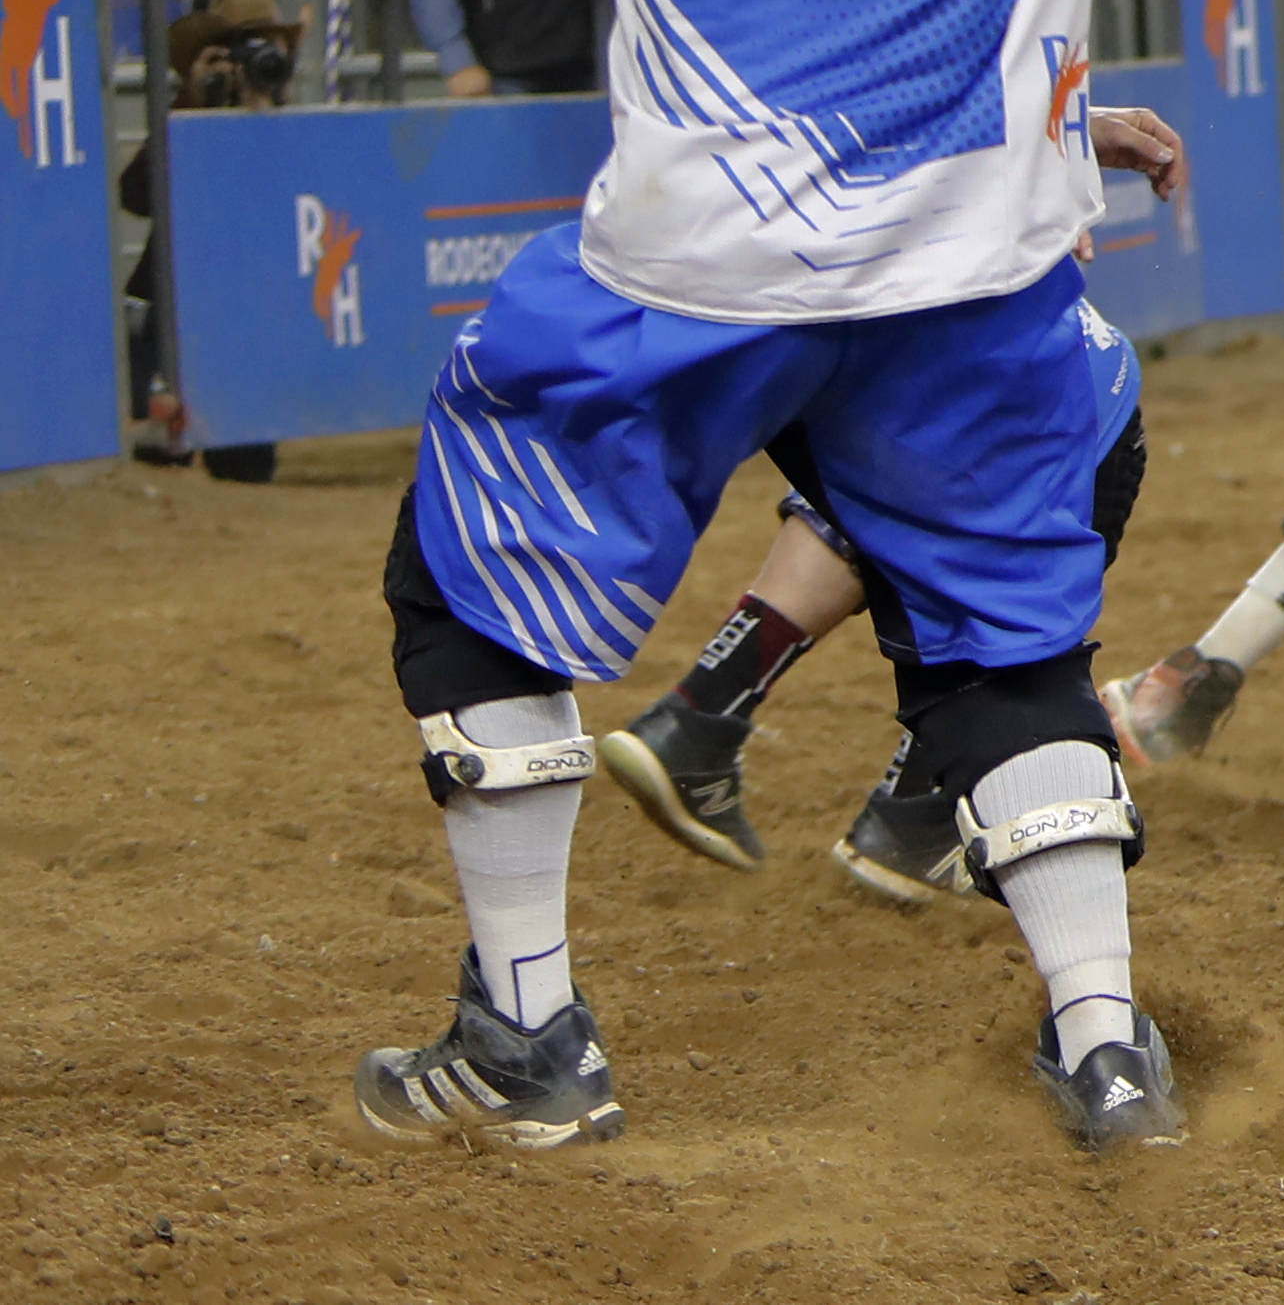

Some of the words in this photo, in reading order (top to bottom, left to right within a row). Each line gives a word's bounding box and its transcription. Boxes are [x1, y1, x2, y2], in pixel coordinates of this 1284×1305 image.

[34, 16, 76, 169] H
[295, 193, 326, 279] R
[332, 262, 364, 348] H
[1102, 1087, 1145, 1113] adidas
